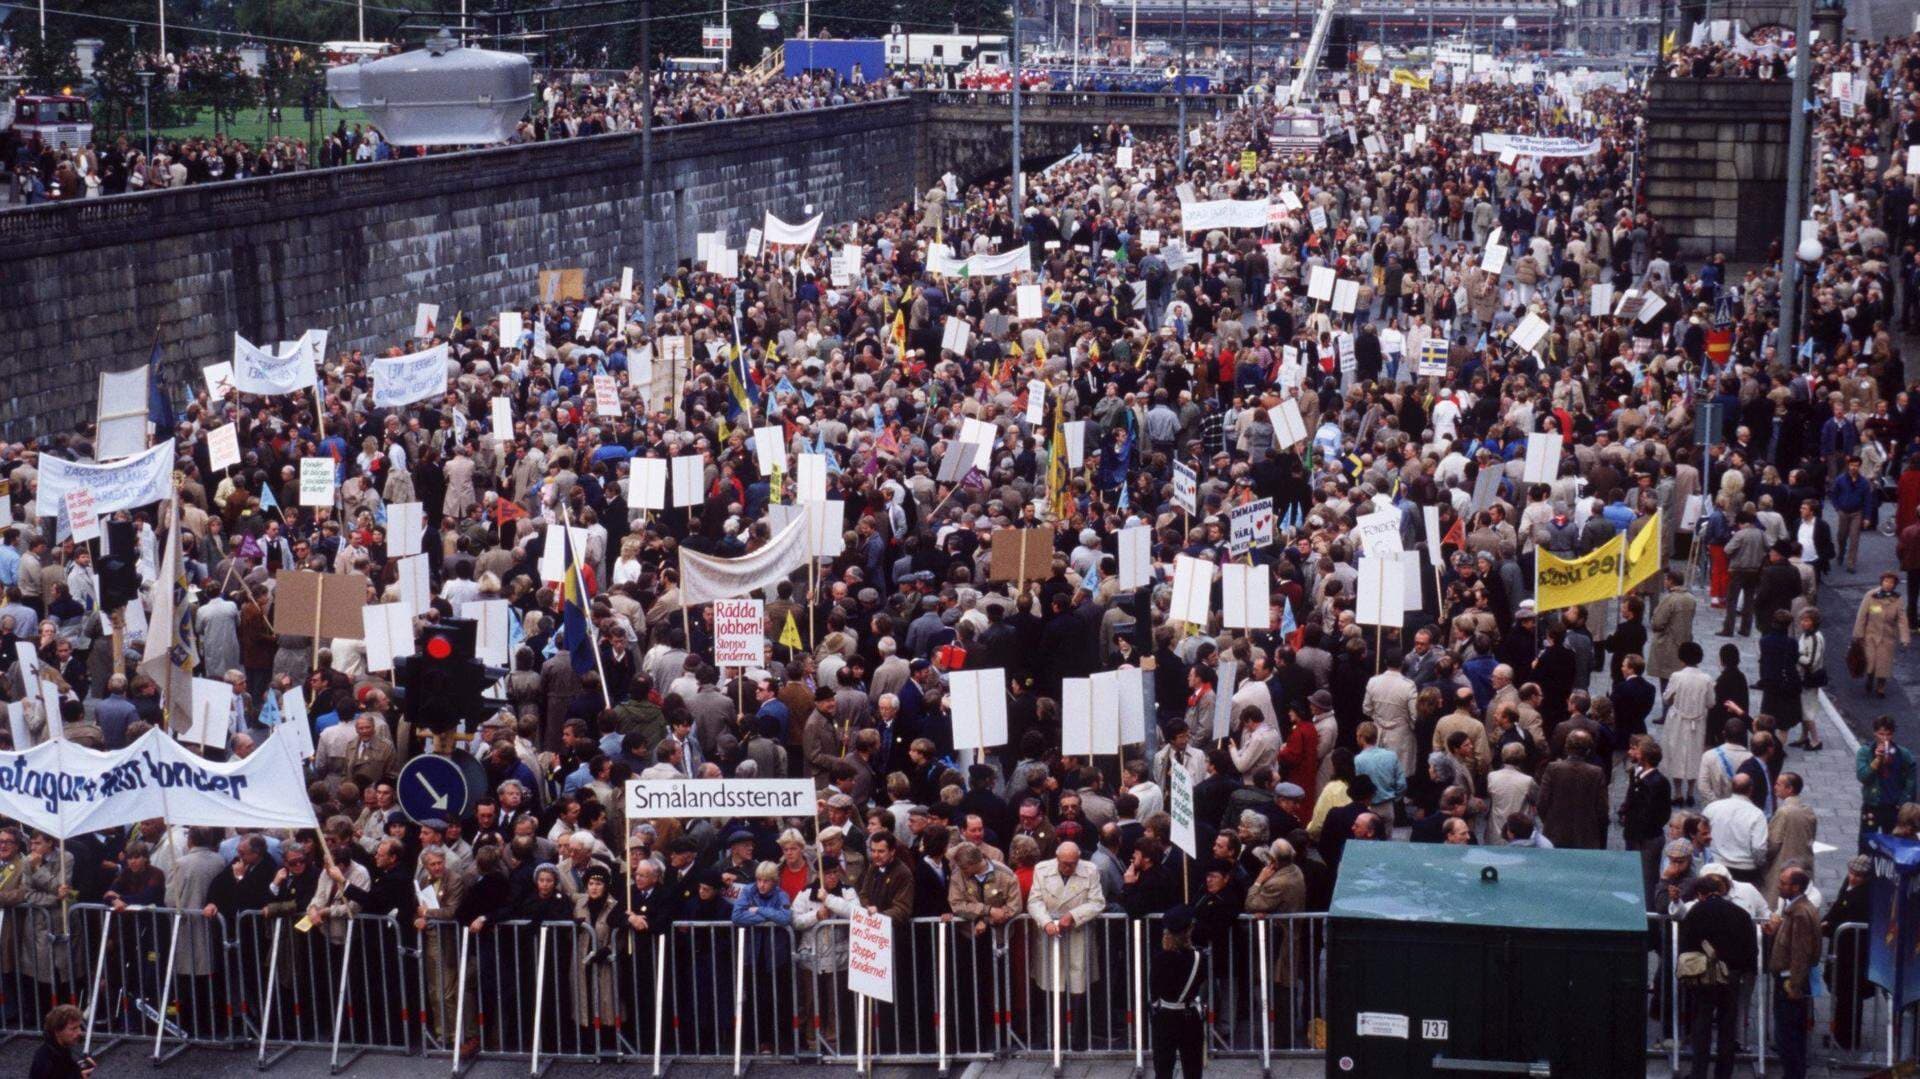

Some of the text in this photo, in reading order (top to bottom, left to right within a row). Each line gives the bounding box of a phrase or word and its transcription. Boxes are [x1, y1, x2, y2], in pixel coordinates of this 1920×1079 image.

[1231, 500, 1272, 519] EMMABODA
[716, 602, 756, 618] Rädda
[716, 616, 763, 639] jobben!
[716, 640, 746, 652] Stoppa
[635, 783, 804, 809] Smålandsstenar
[851, 941, 877, 960] Stoppa
[1423, 1021, 1448, 1037] 737
